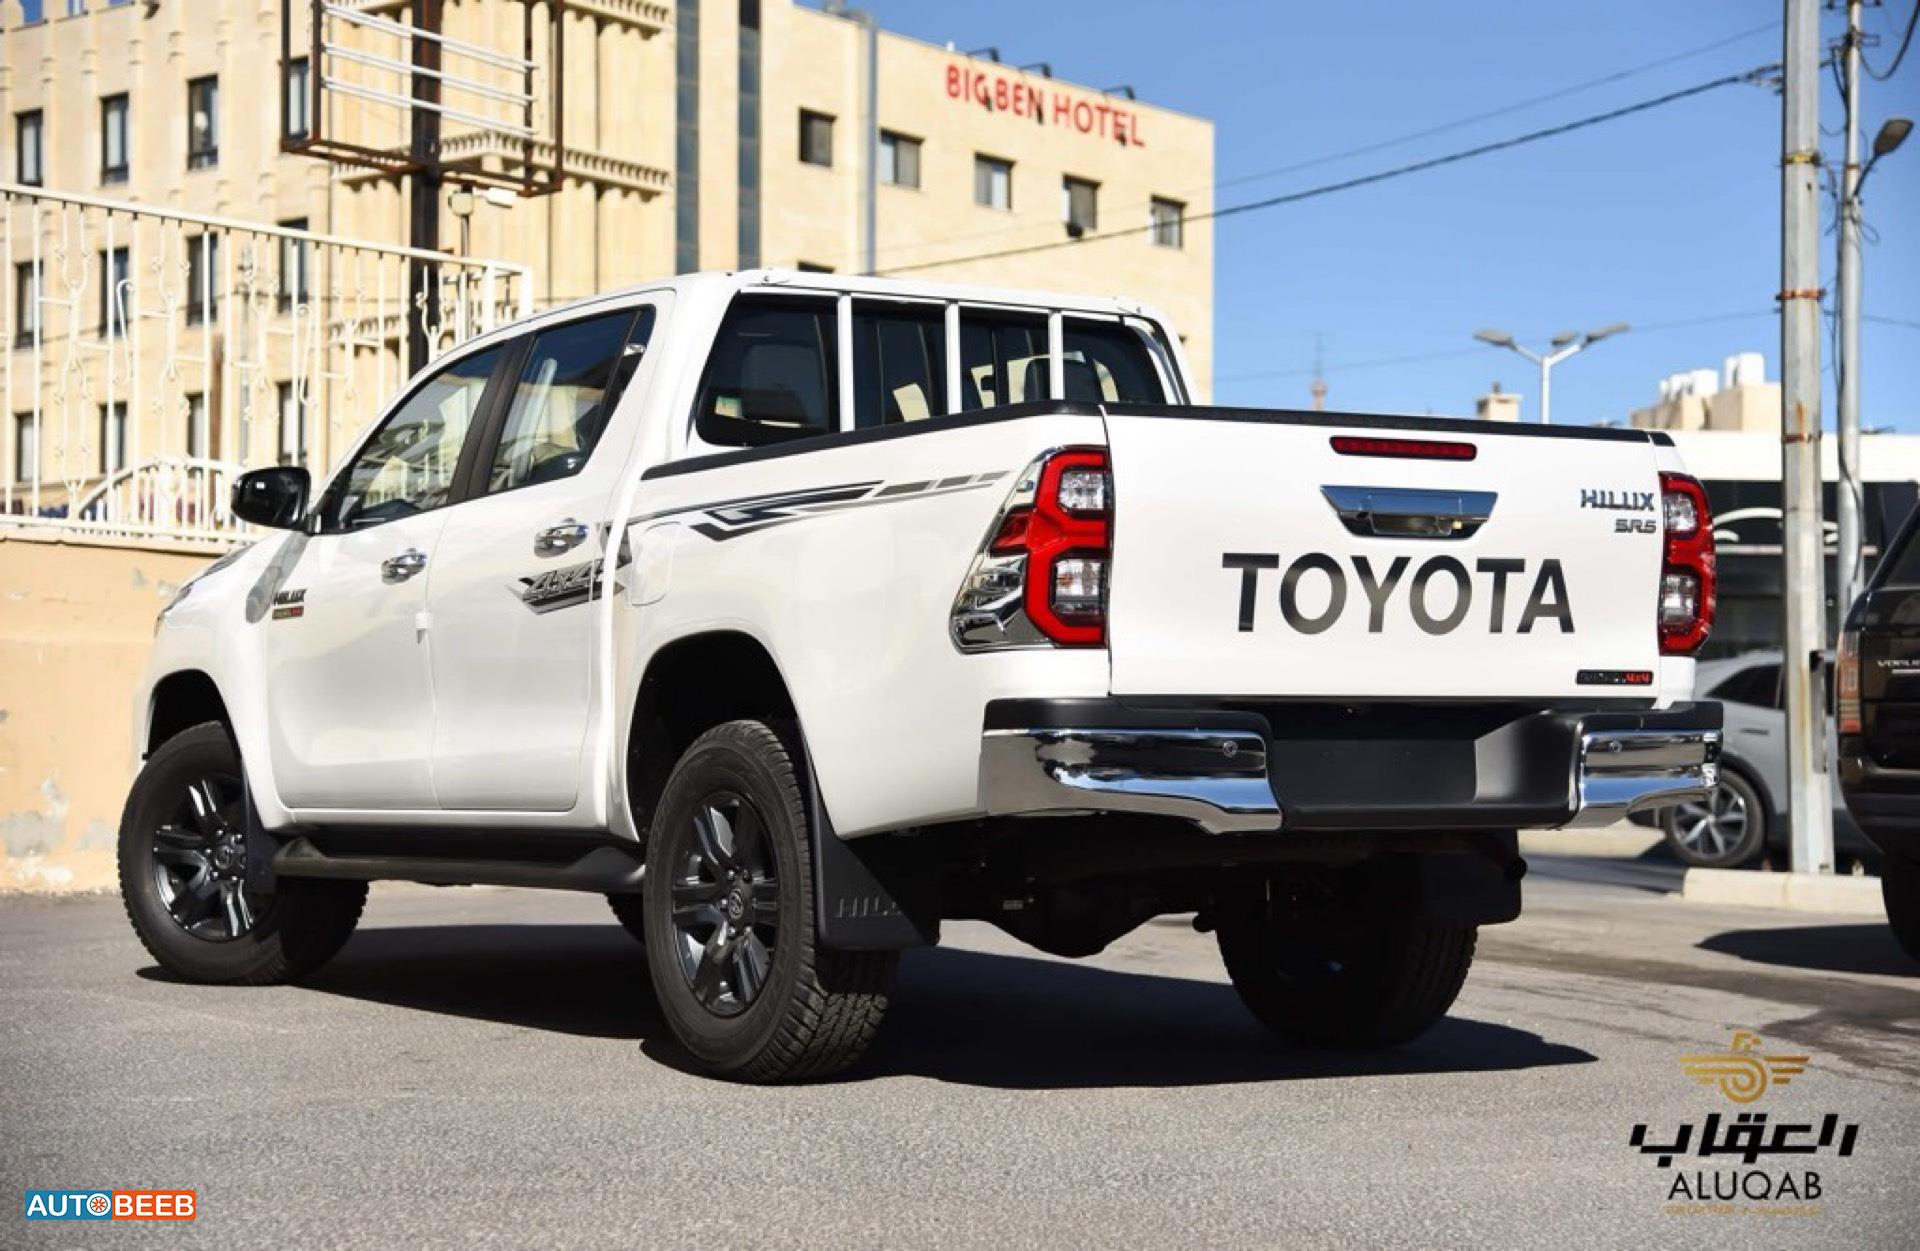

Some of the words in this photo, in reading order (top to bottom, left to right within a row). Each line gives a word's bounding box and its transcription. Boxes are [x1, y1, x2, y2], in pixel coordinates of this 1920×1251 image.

[946, 65, 990, 107] BIG
[995, 78, 1044, 119] BEN
[1052, 92, 1146, 147] HOTEL
[1580, 489, 1655, 512] HILUX
[1614, 518, 1657, 533] SR5
[1222, 552, 1575, 635] TOYOTA
